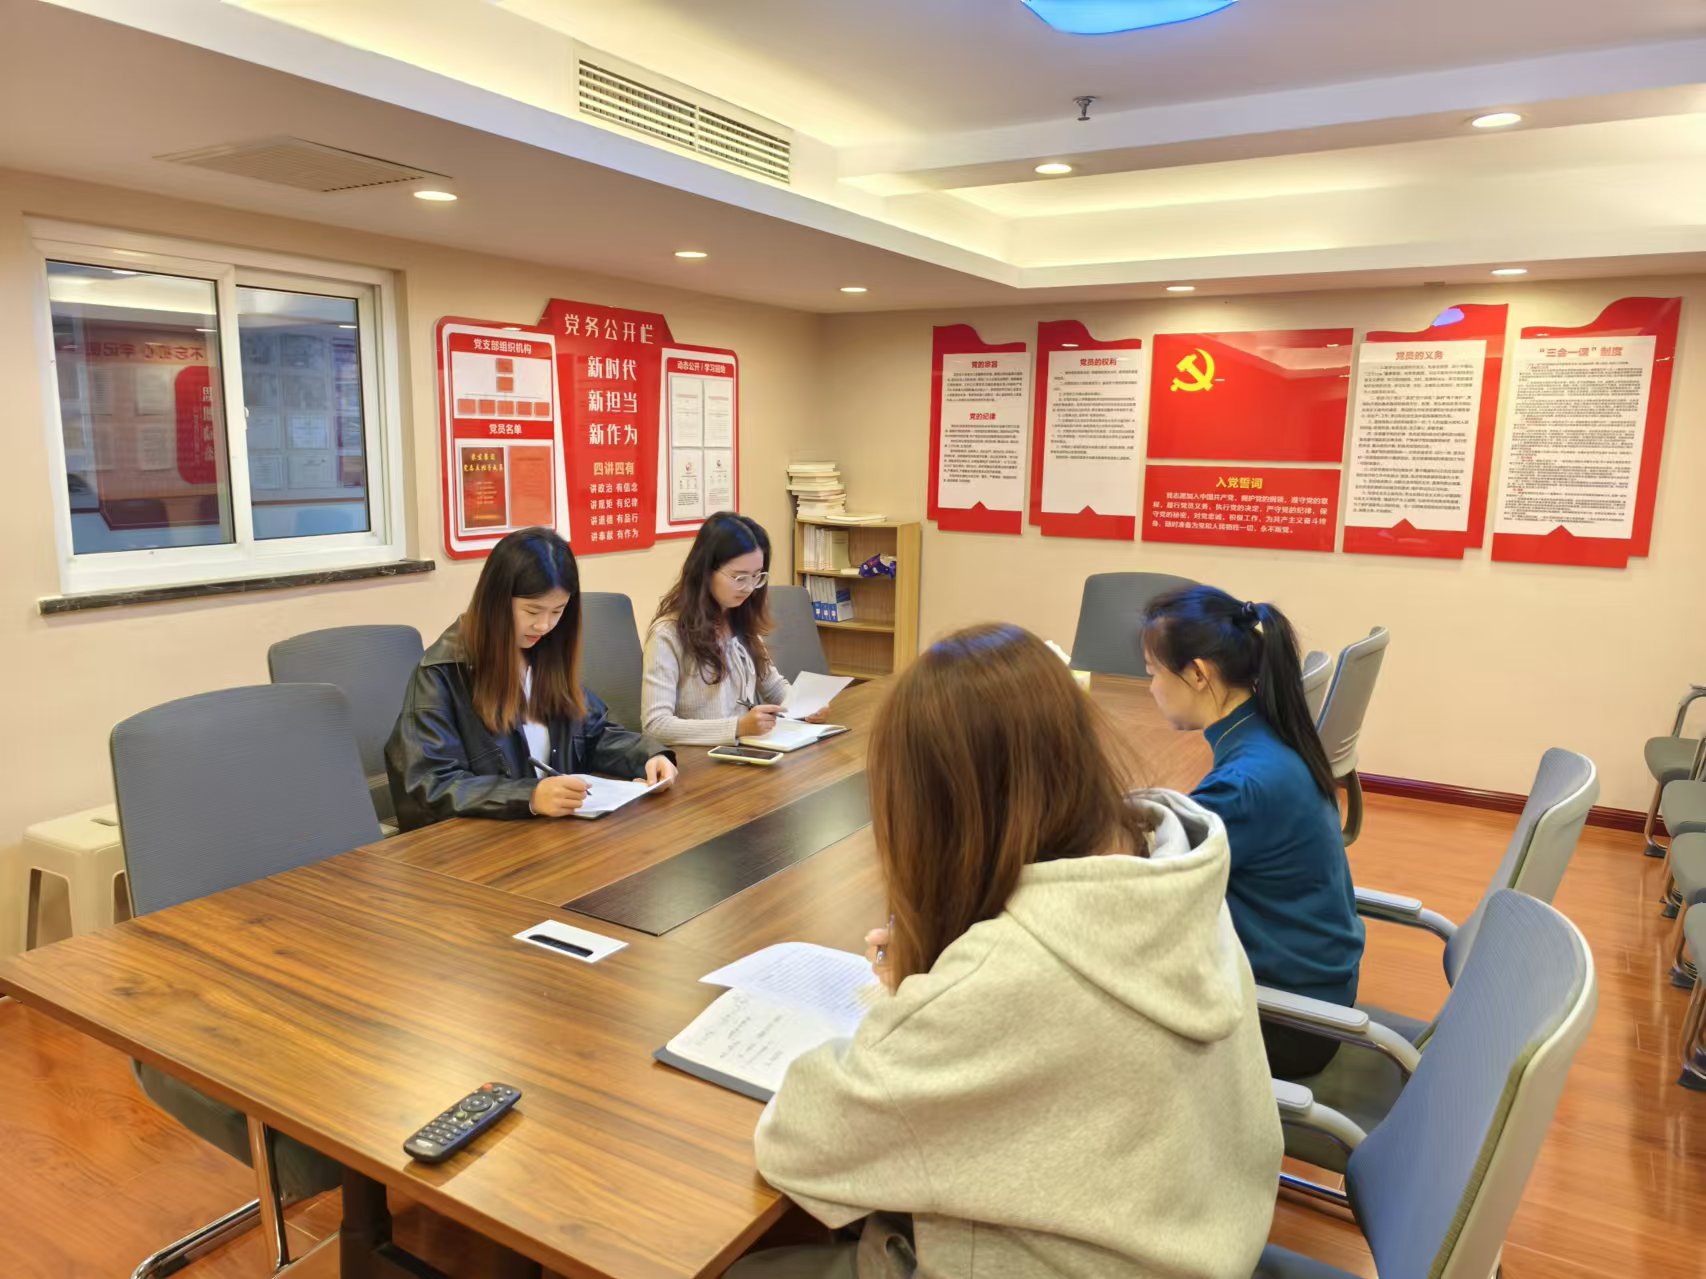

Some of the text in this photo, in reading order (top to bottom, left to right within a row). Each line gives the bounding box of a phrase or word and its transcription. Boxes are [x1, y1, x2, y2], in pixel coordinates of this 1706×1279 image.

[564, 313, 654, 344] 党务公开栏
[473, 338, 532, 354] 党支部组织机构
[1395, 350, 1444, 361] 党员的义务
[588, 355, 637, 381] 新时代
[1079, 358, 1117, 367] 党员的权利
[588, 389, 638, 414] 新担当
[489, 423, 523, 435] 党员名单
[589, 423, 638, 446] 新作为
[593, 461, 635, 476] 四讲四有
[589, 482, 639, 494] 讲政治 有信念
[1215, 476, 1264, 490] 入党誓词
[616, 497, 639, 509] 有纪律
[616, 513, 639, 525] 有品行
[616, 528, 639, 540] 有作为
